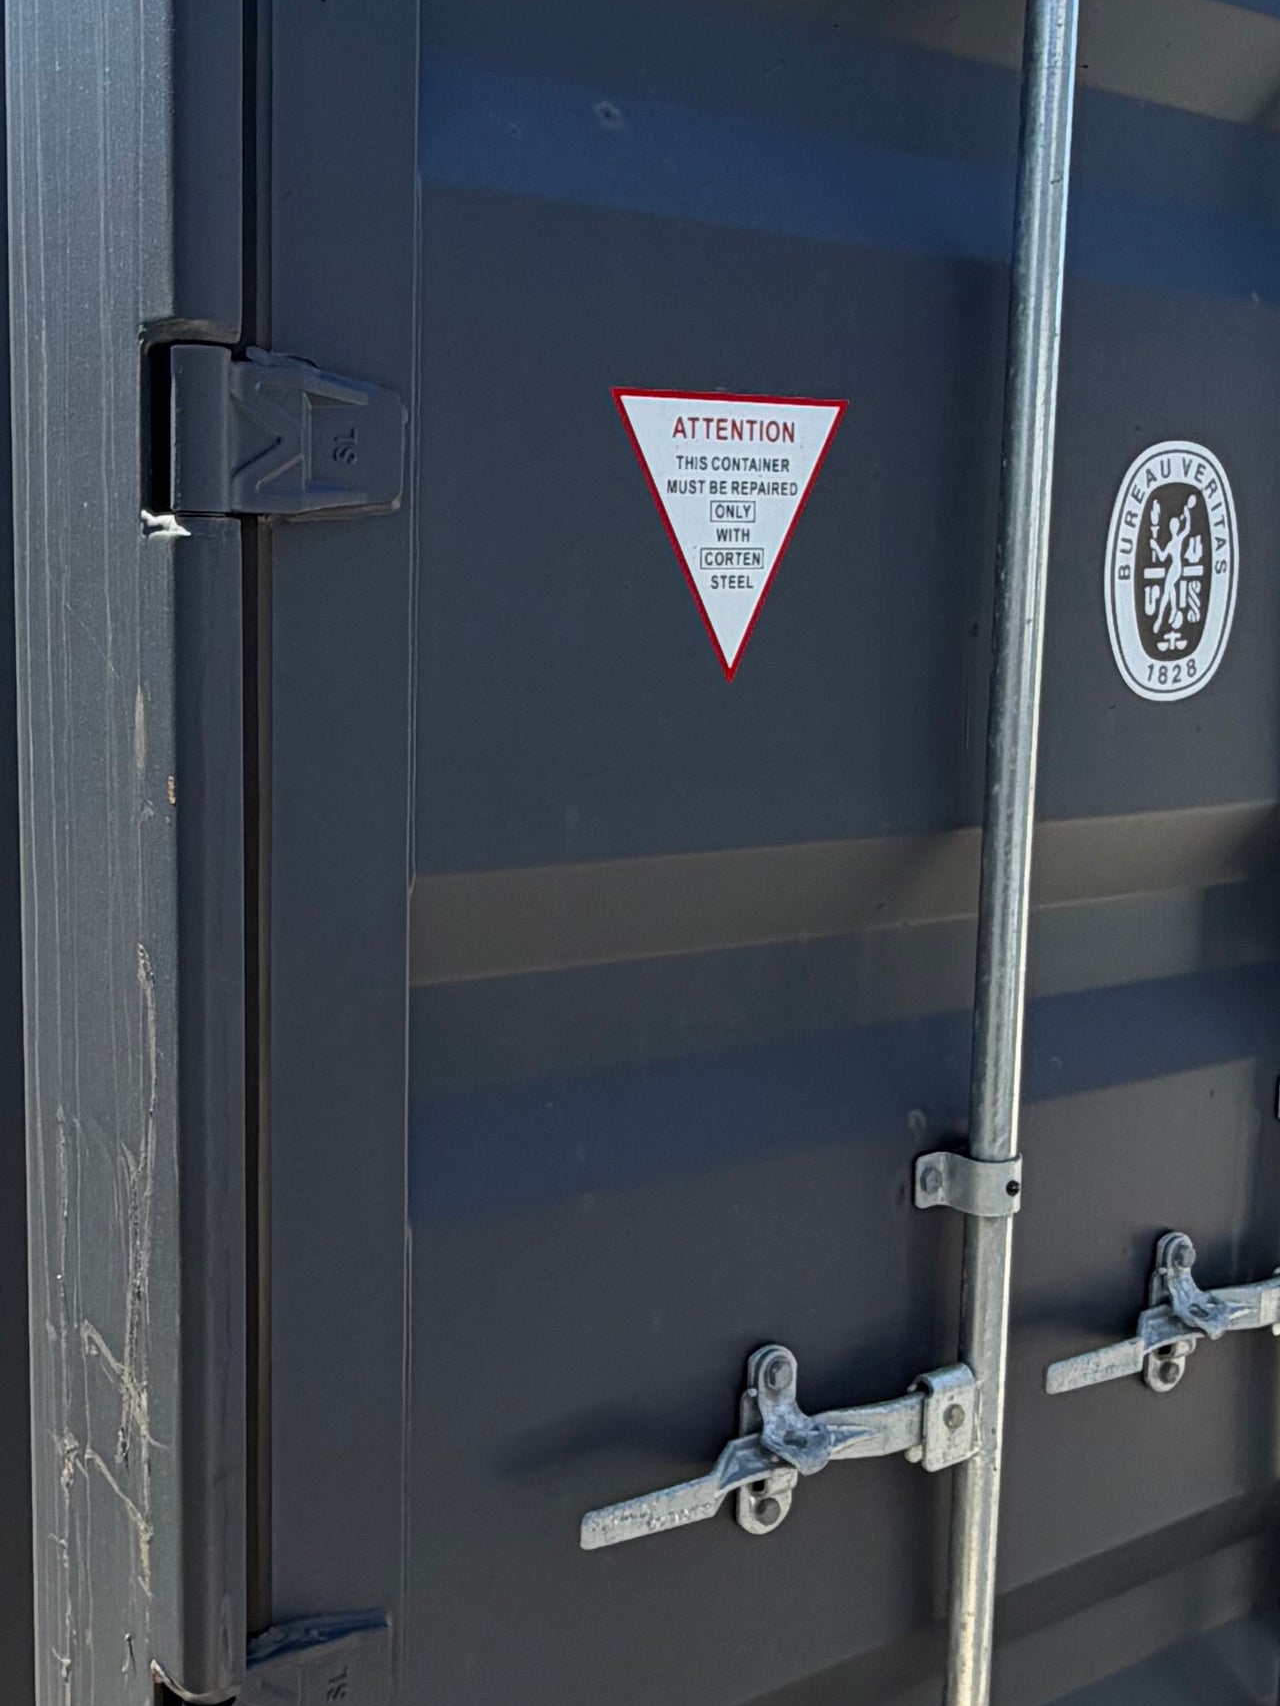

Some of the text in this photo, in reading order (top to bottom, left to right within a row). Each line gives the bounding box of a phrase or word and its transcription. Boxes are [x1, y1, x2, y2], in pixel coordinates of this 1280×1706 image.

[672, 416, 796, 443] ATTENTION
[676, 455, 790, 473] THIS CONTAINER
[667, 479, 798, 497] MUST BE REPAIRED
[715, 504, 752, 520] ONLY
[1118, 457, 1228, 581] BUREAU VERITAS
[716, 528, 751, 543] WITH
[704, 551, 761, 566] CORTEN
[710, 575, 754, 590] STEEL
[1146, 658, 1198, 685] 1828
